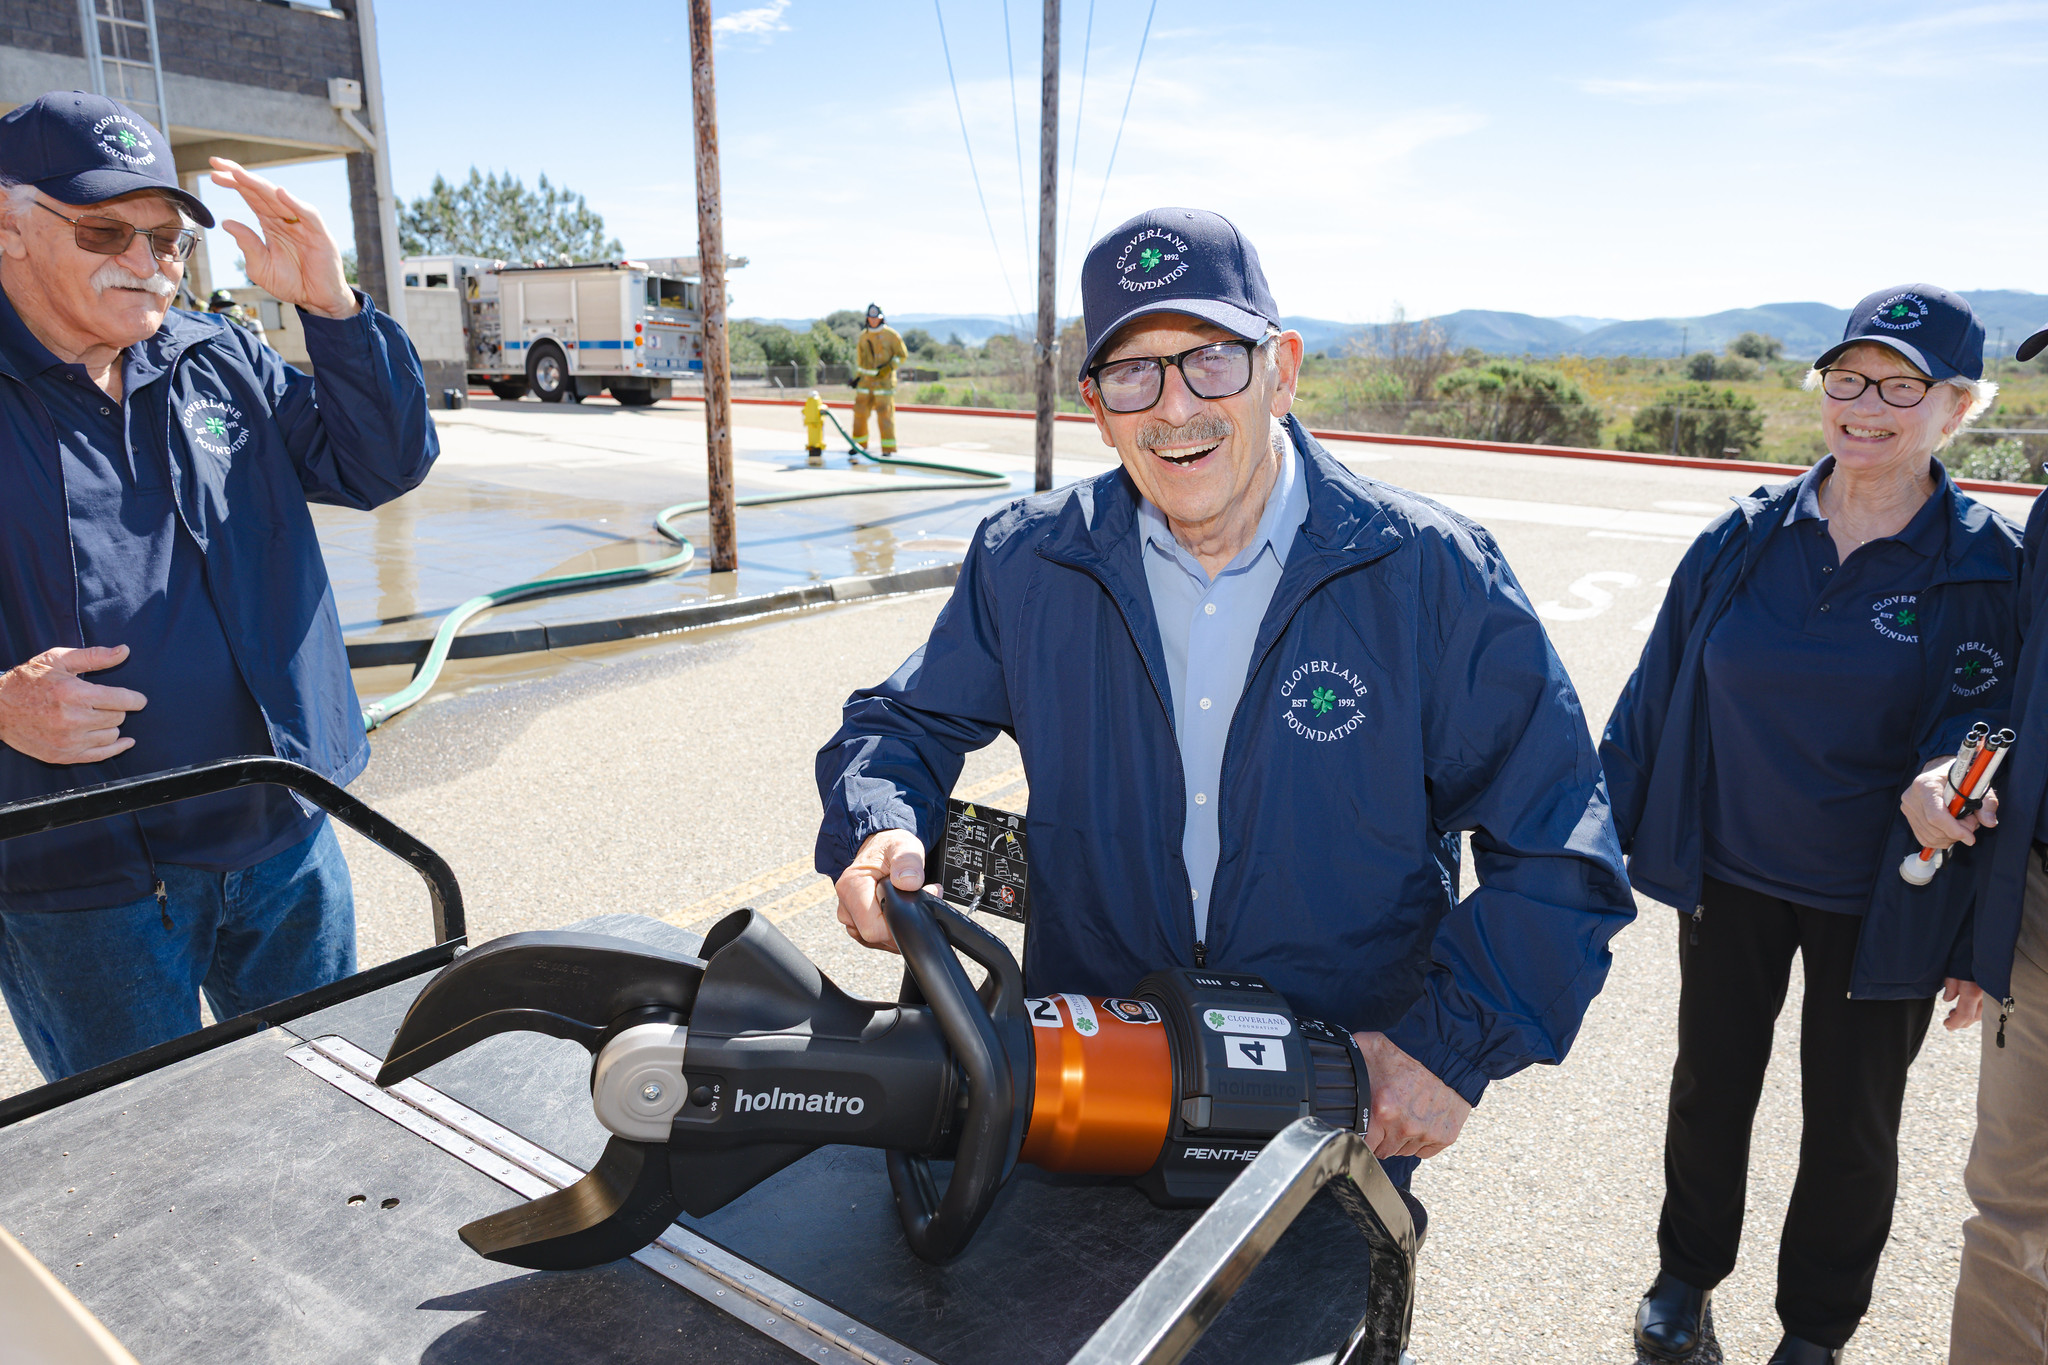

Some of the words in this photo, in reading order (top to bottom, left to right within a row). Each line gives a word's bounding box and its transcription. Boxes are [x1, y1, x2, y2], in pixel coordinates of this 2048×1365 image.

[93, 115, 152, 145] CLOVERLANE
[97, 141, 156, 166] FOUNDATION
[1116, 228, 1188, 269] CLOVERLANE
[1124, 263, 1137, 274] EST
[1163, 253, 1179, 261] 1992
[1118, 261, 1189, 292] FOUNDATION
[1876, 293, 1928, 315] CLOVERLANE
[1871, 315, 1922, 330] FOUNDATION
[183, 399, 242, 428] CLOVERLANE
[226, 421, 239, 429] 1992
[195, 427, 249, 454] FOUNDATION
[1872, 595, 1916, 612] CLOVER
[1871, 617, 1919, 643] FOUNDAT
[1956, 642, 2004, 668] VERLANE
[1281, 660, 1367, 697] CLOVERLANE
[1952, 676, 1999, 697] UNDATION
[1291, 699, 1308, 708] EST
[1337, 699, 1355, 707] 1992
[1282, 709, 1366, 742] FOUNDATION
[1227, 1014, 1286, 1026] CLOVERLANE
[1238, 1040, 1266, 1066] 4
[734, 1087, 865, 1115] holmatro
[1218, 1079, 1298, 1098] holmatro
[1183, 1147, 1259, 1161] PENTHE
